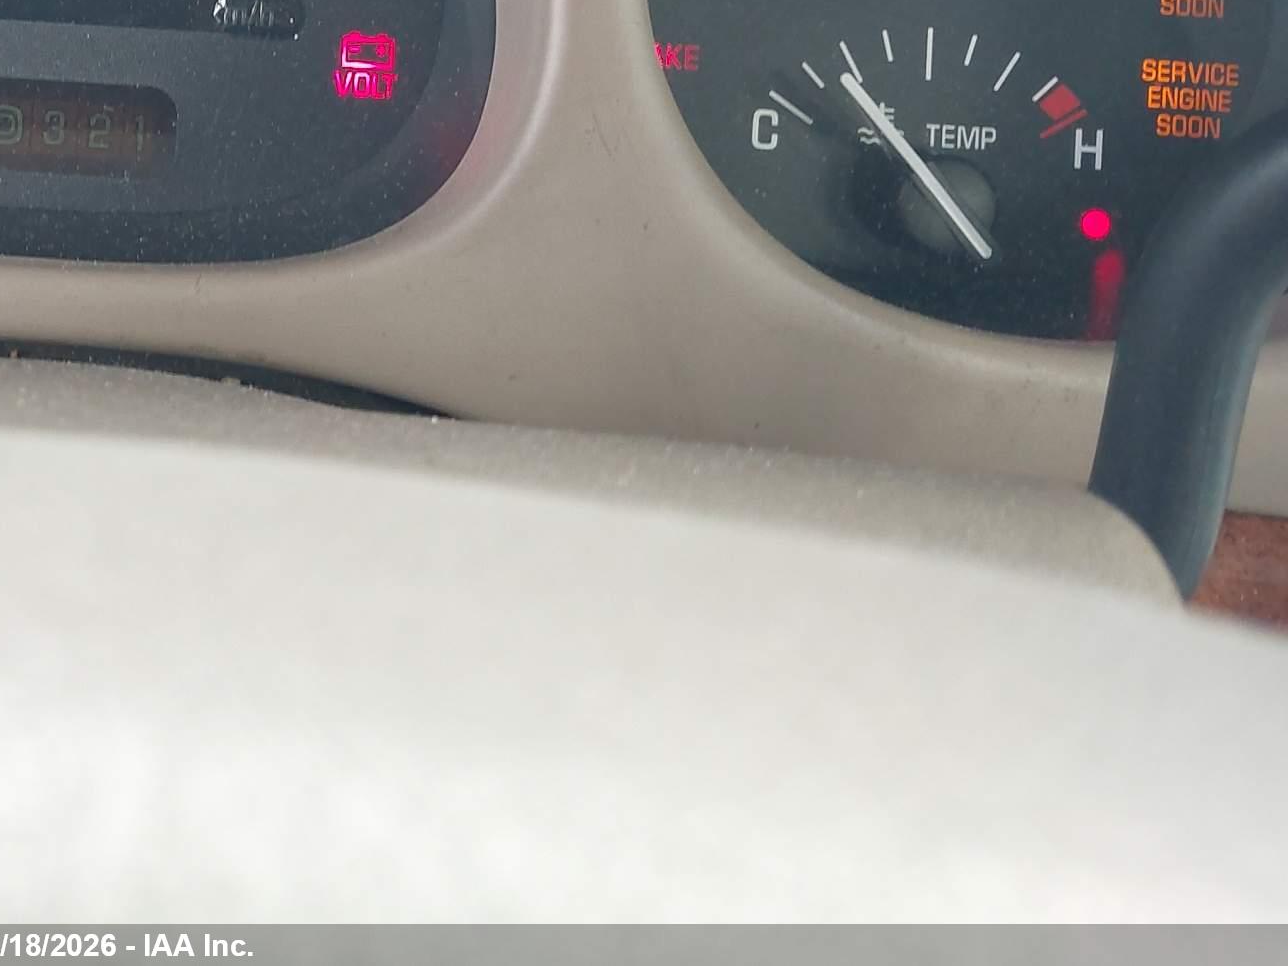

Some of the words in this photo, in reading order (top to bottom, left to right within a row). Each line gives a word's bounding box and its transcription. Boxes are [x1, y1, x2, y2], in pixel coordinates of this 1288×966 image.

[333, 70, 398, 100] VOLT
[1141, 58, 1240, 87] SERVICE
[1147, 85, 1232, 113] ENGINE
[43, 110, 66, 146] 3
[89, 113, 112, 151] 2
[751, 108, 779, 152] C
[926, 124, 997, 150] TEMP
[1156, 113, 1222, 139] SOON
[1073, 128, 1103, 170] H
